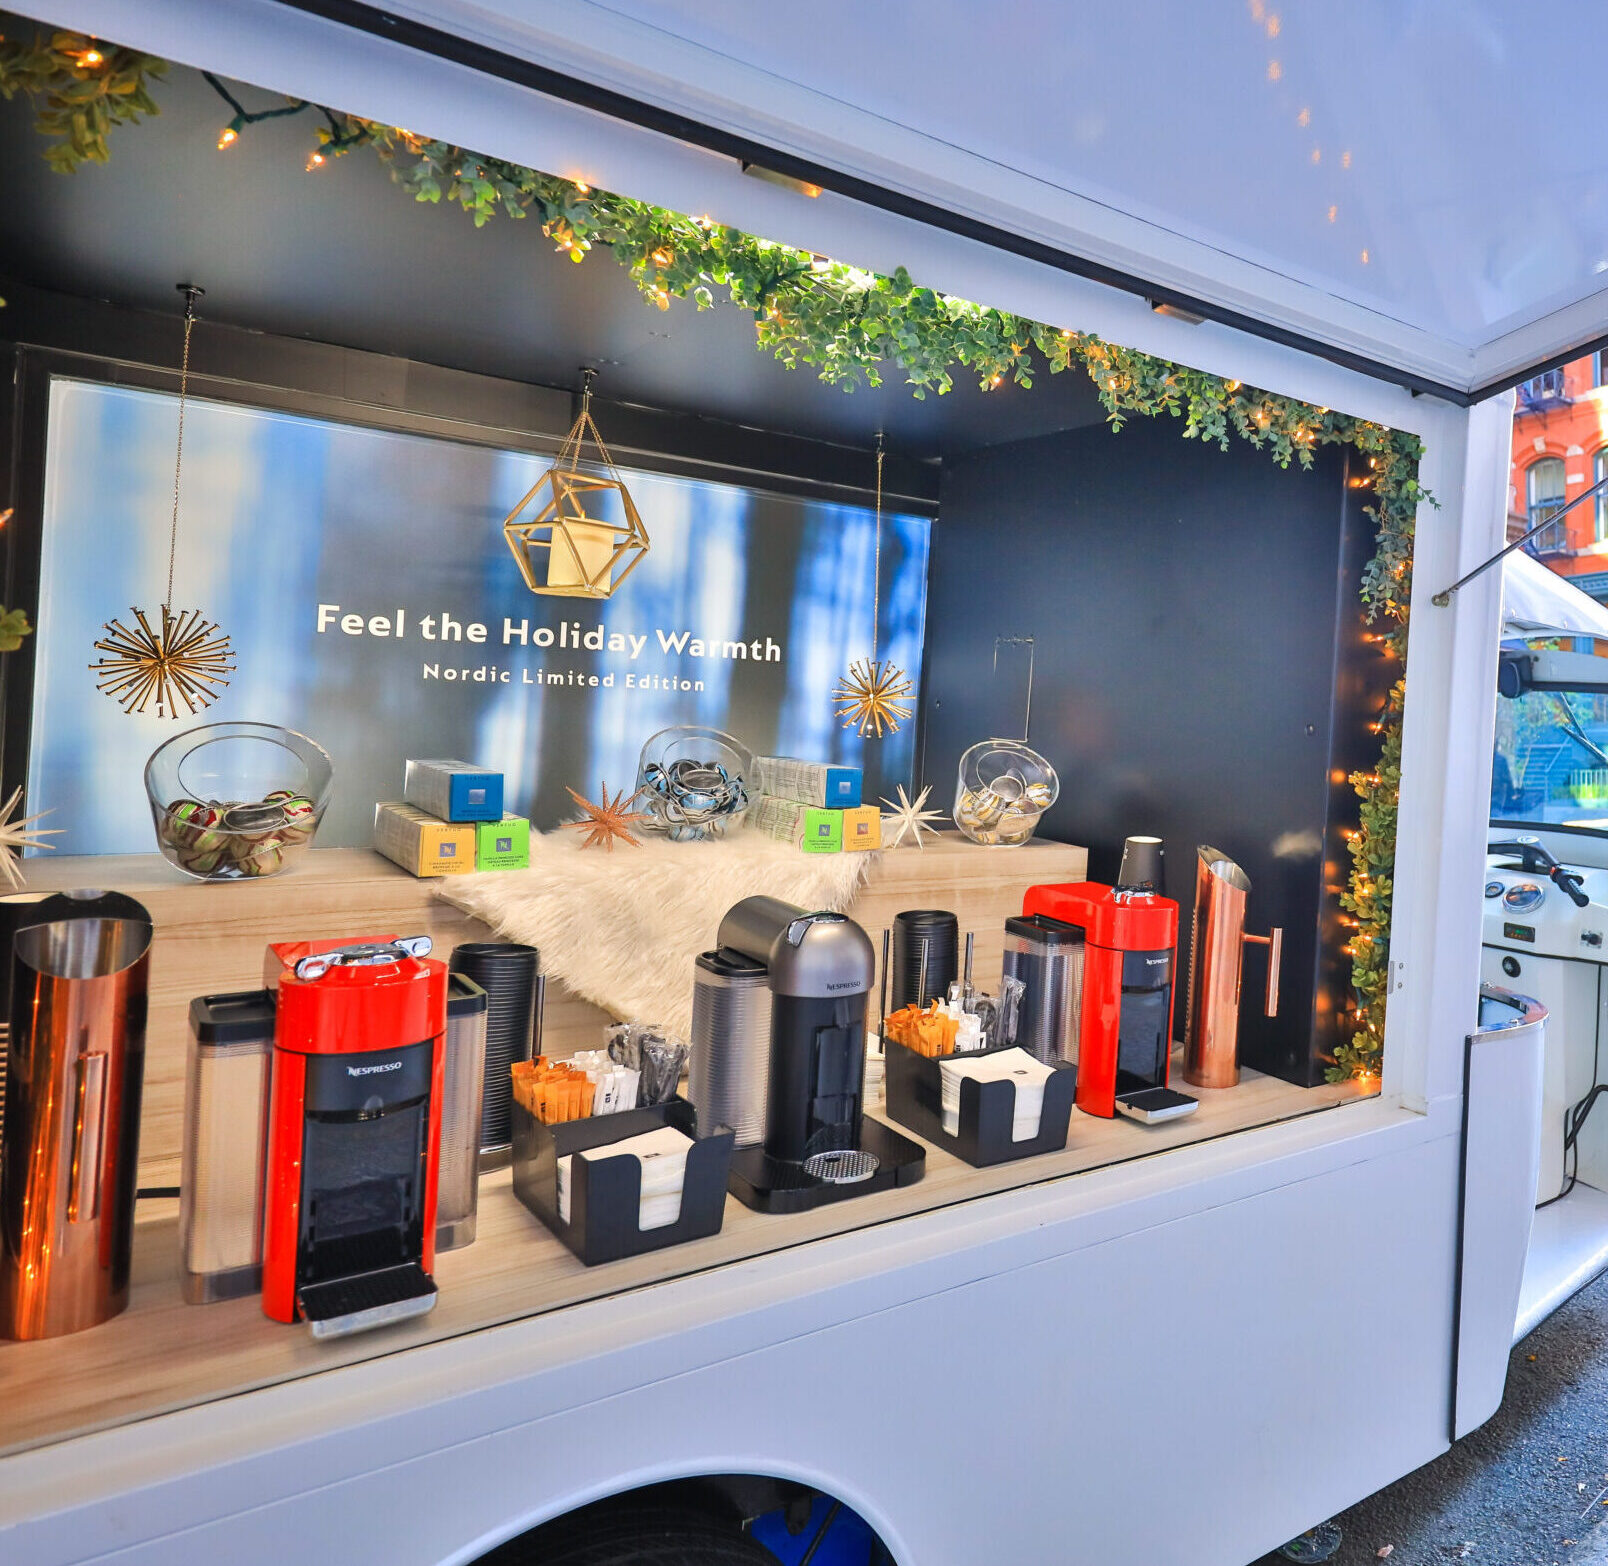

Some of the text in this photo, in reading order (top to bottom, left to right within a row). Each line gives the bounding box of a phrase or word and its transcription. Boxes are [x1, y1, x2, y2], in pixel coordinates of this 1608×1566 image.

[316, 603, 782, 662] Feel the Holiday Warmth
[422, 663, 705, 692] Nordic Limited Edition
[346, 1061, 402, 1076] NESPRESSO
